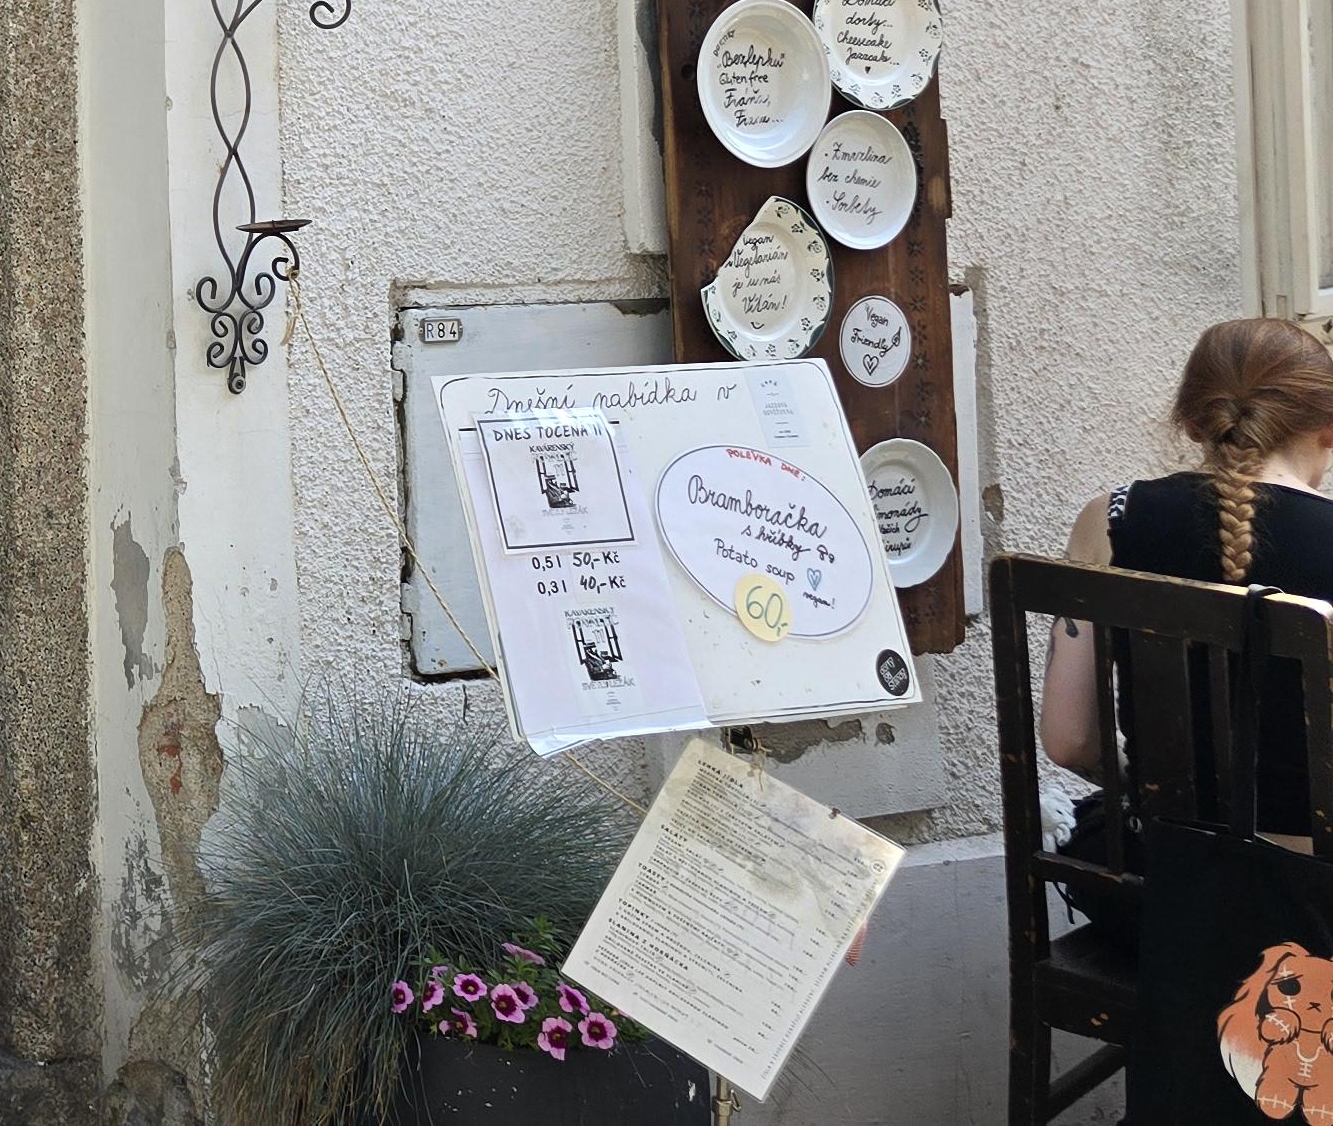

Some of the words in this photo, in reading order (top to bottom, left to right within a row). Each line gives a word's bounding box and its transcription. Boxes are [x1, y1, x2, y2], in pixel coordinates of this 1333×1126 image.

[864, 303, 889, 328] Vegan
[483, 383, 576, 415] Dnešní
[593, 377, 697, 409] nabídka
[492, 427, 532, 442] DNES
[688, 475, 828, 539] Bramboračka
[714, 538, 758, 568] Potato
[765, 564, 795, 585] soup
